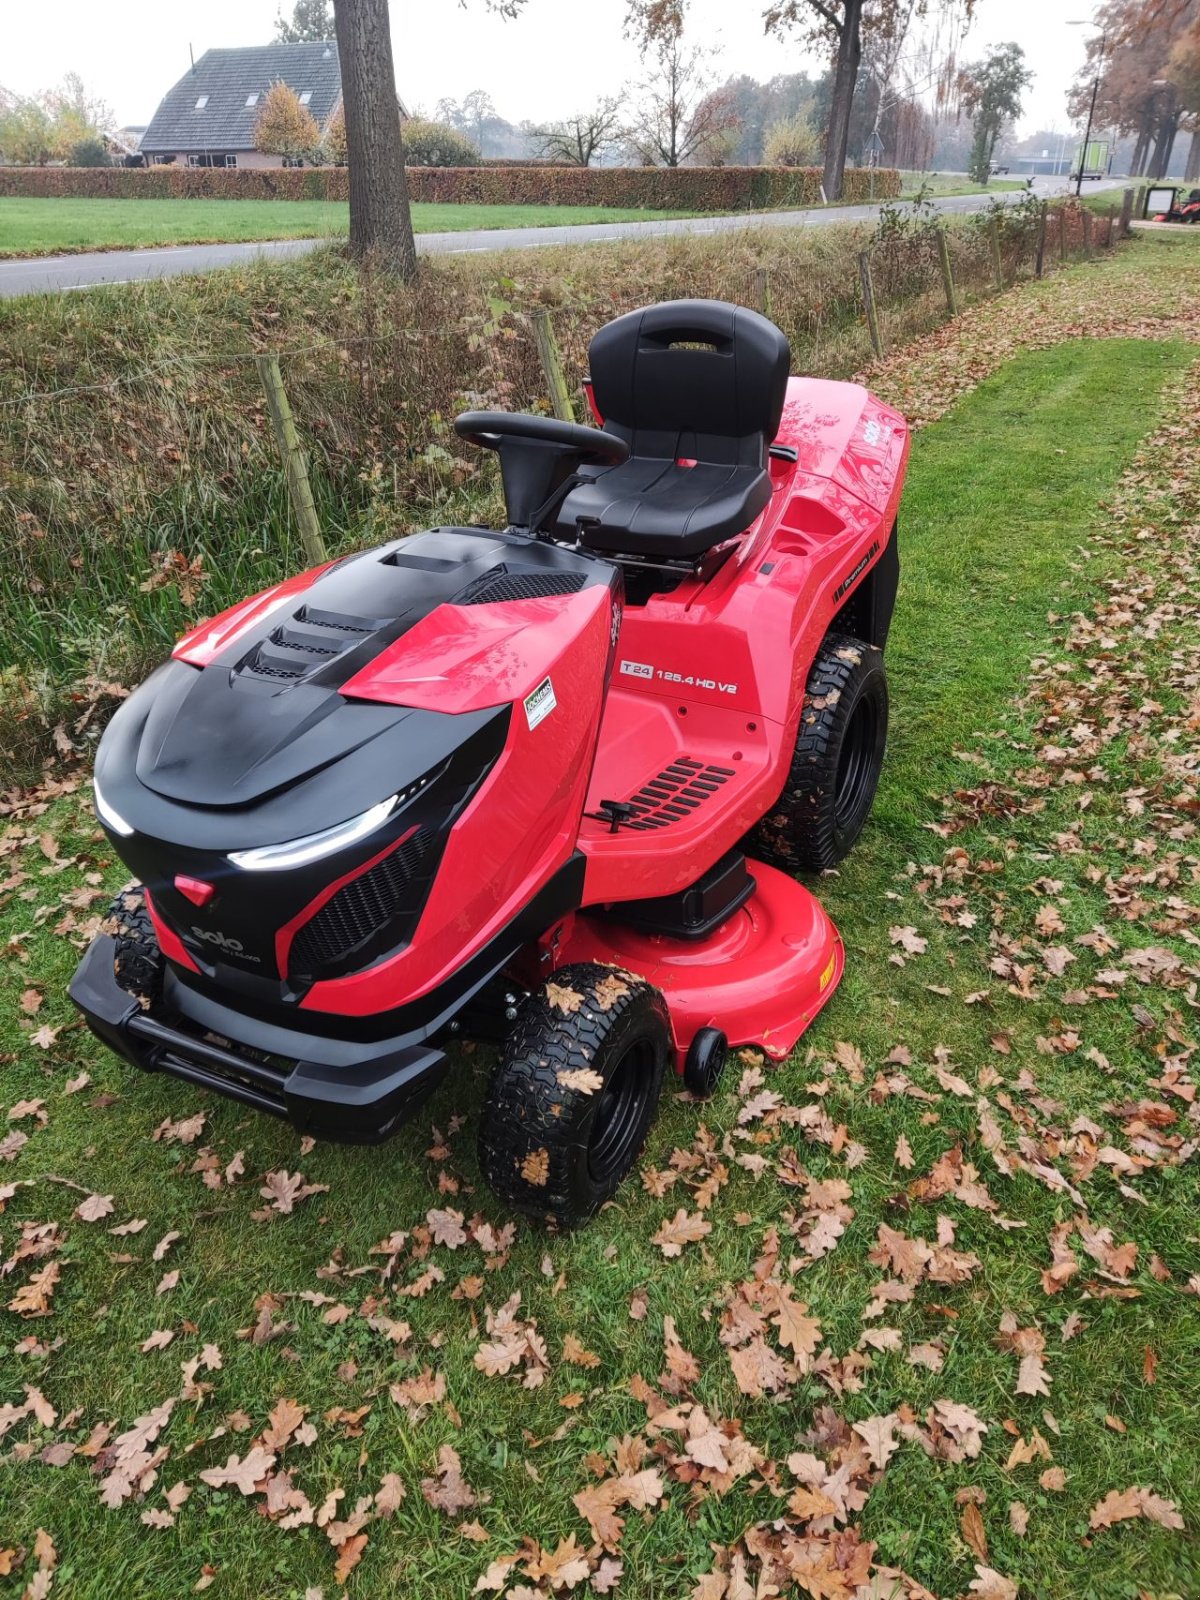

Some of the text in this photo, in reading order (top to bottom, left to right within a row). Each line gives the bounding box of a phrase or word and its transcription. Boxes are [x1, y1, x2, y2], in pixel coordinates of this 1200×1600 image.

[623, 663, 737, 695] T 24 125.4 HD V2
[191, 926, 244, 951] solo
